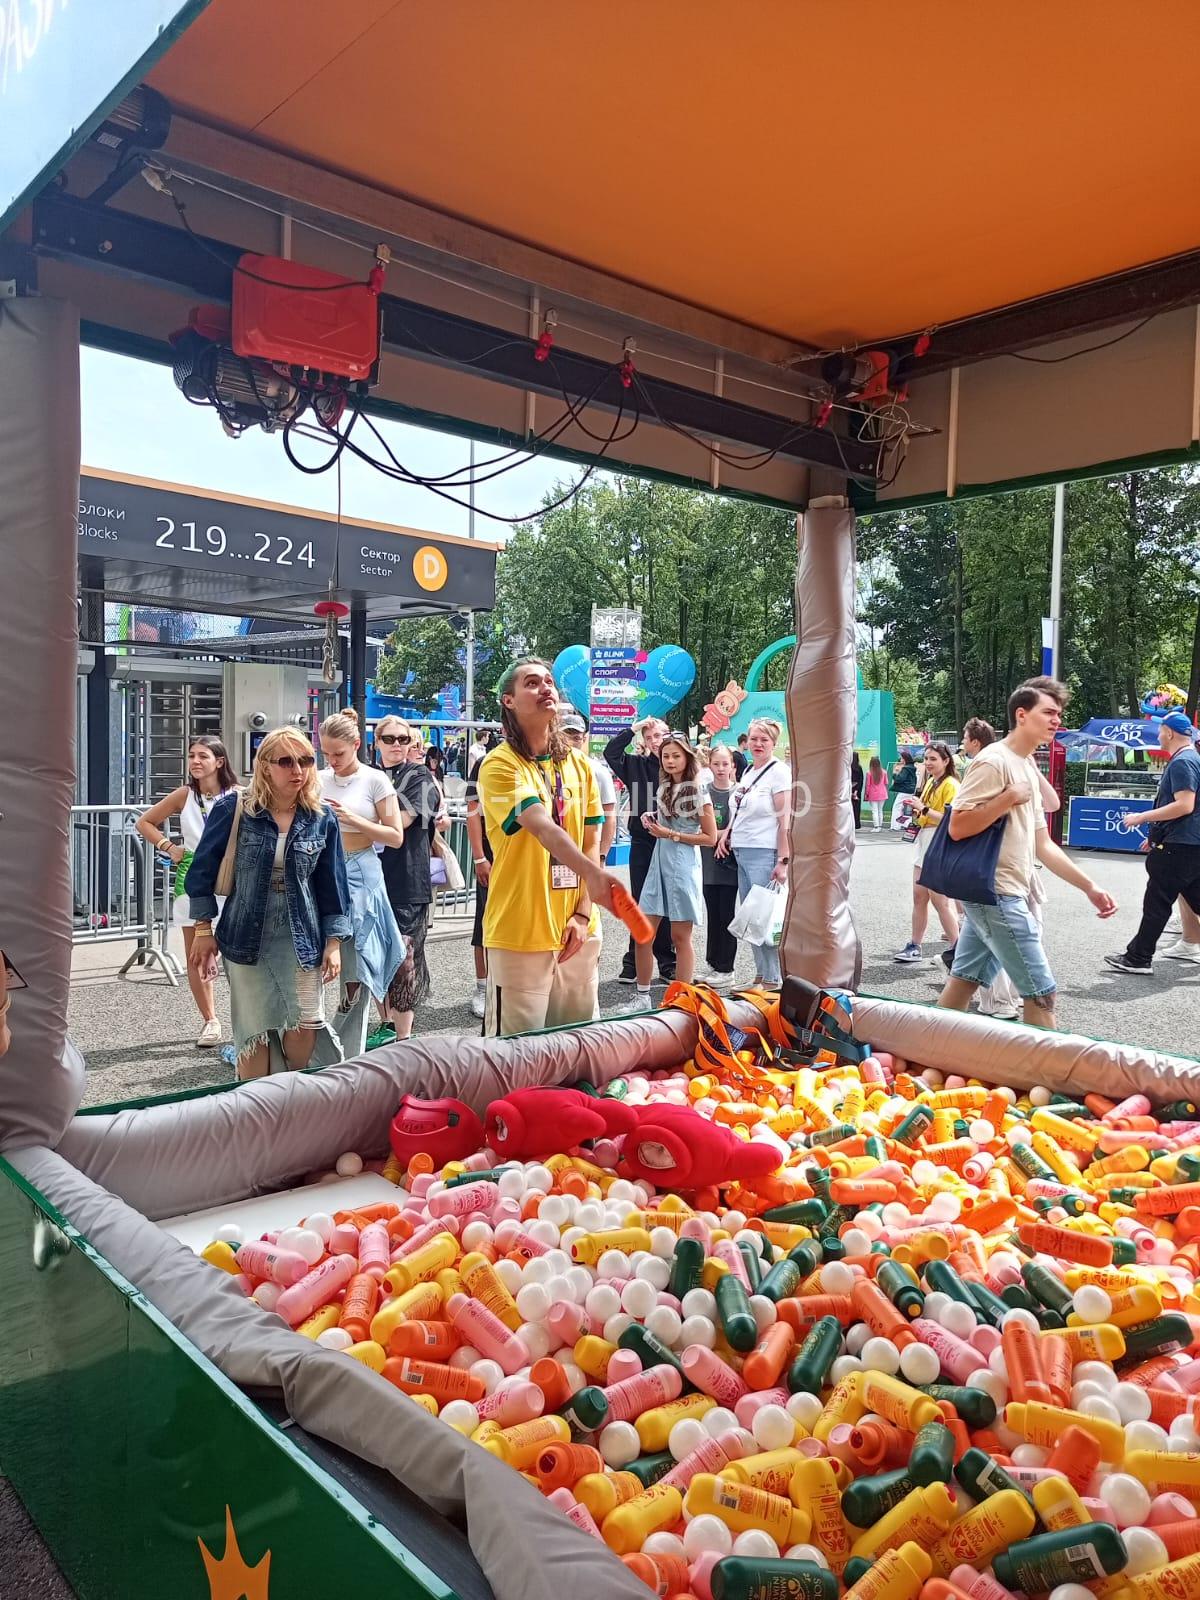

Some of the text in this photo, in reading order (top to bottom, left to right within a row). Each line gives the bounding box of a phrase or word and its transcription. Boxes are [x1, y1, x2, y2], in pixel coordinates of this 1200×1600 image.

[78, 499, 125, 520] Блоки
[78, 522, 118, 540] Blocks
[360, 546, 401, 564] Сектор
[360, 563, 393, 577] Sector
[423, 553, 440, 579] D
